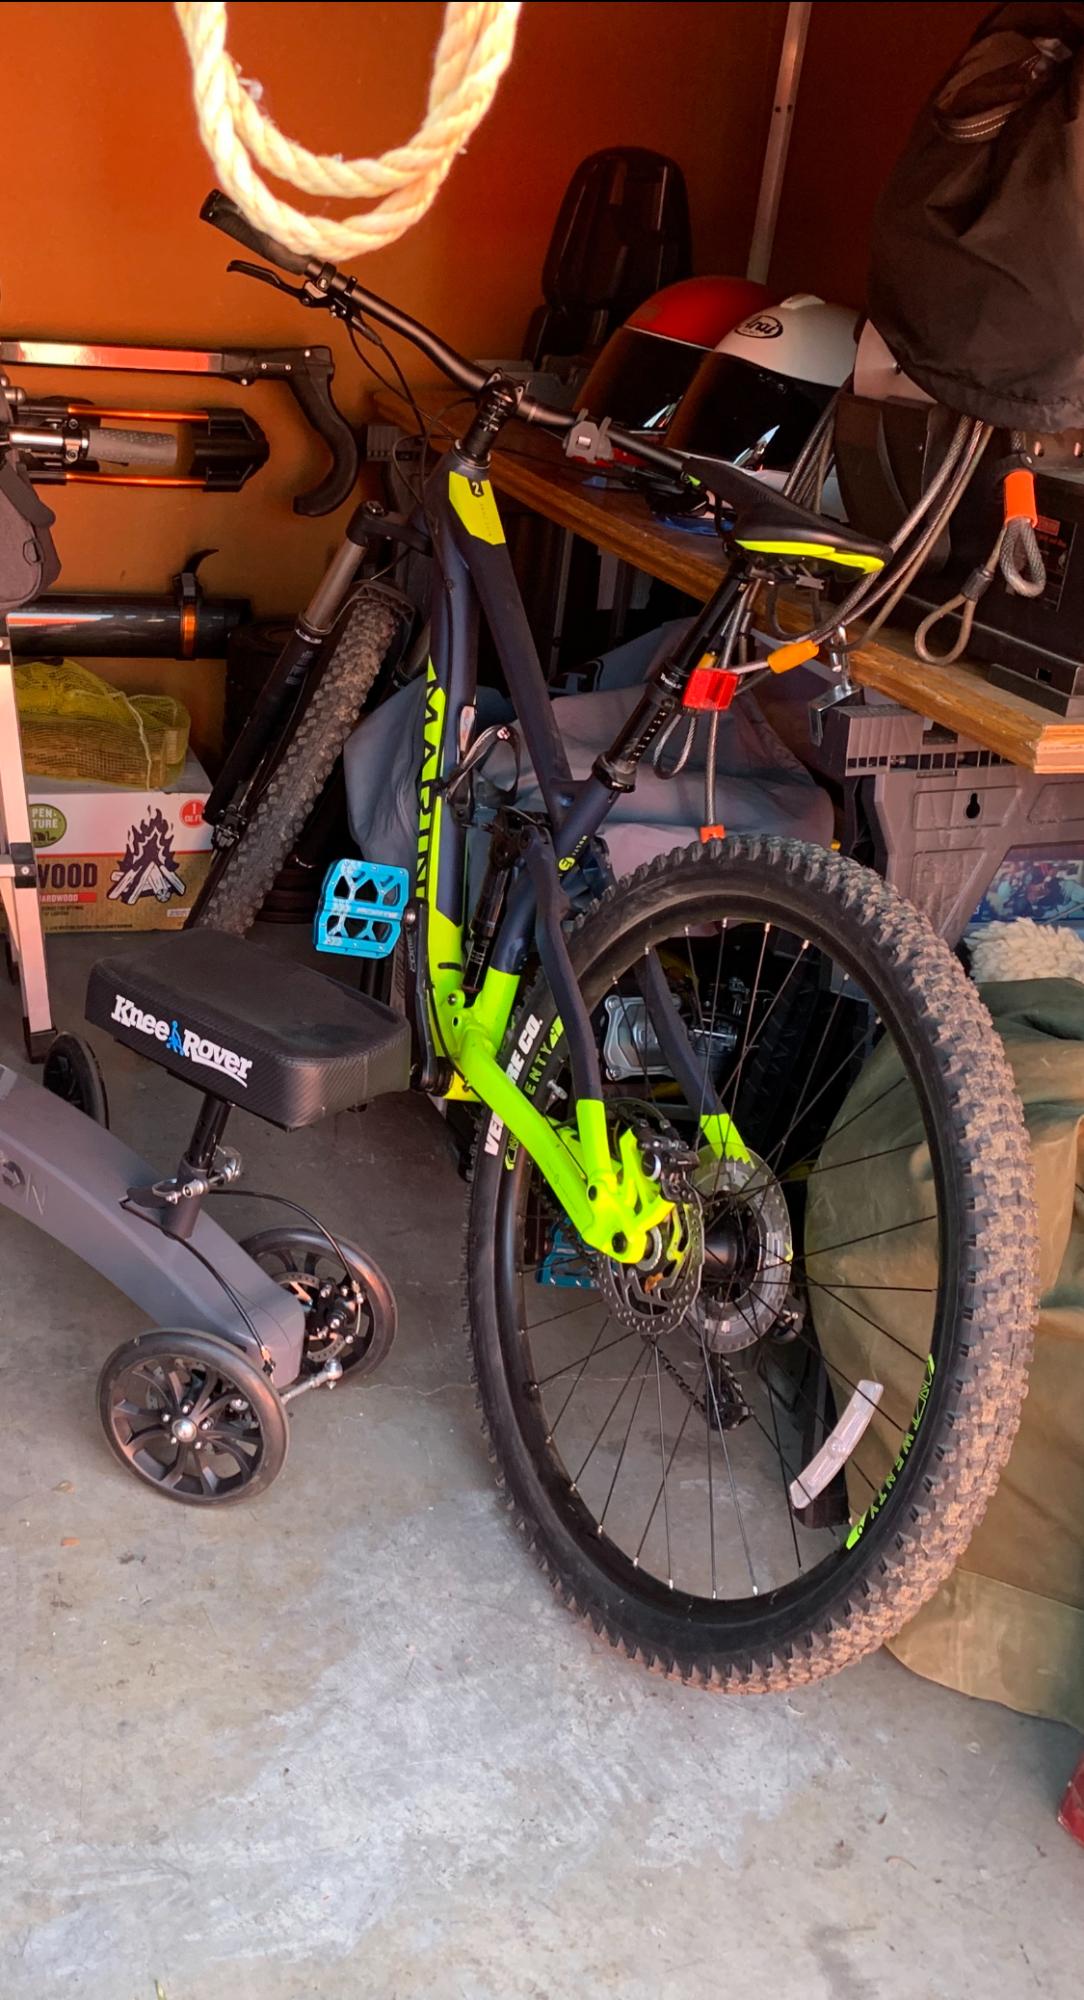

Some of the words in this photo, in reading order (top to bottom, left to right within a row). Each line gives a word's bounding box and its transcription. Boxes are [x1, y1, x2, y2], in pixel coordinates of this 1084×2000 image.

[414, 679, 441, 903] MARIN
[110, 994, 171, 1042] Knee
[182, 1028, 253, 1084] Rover
[517, 1013, 544, 1056] CO.
